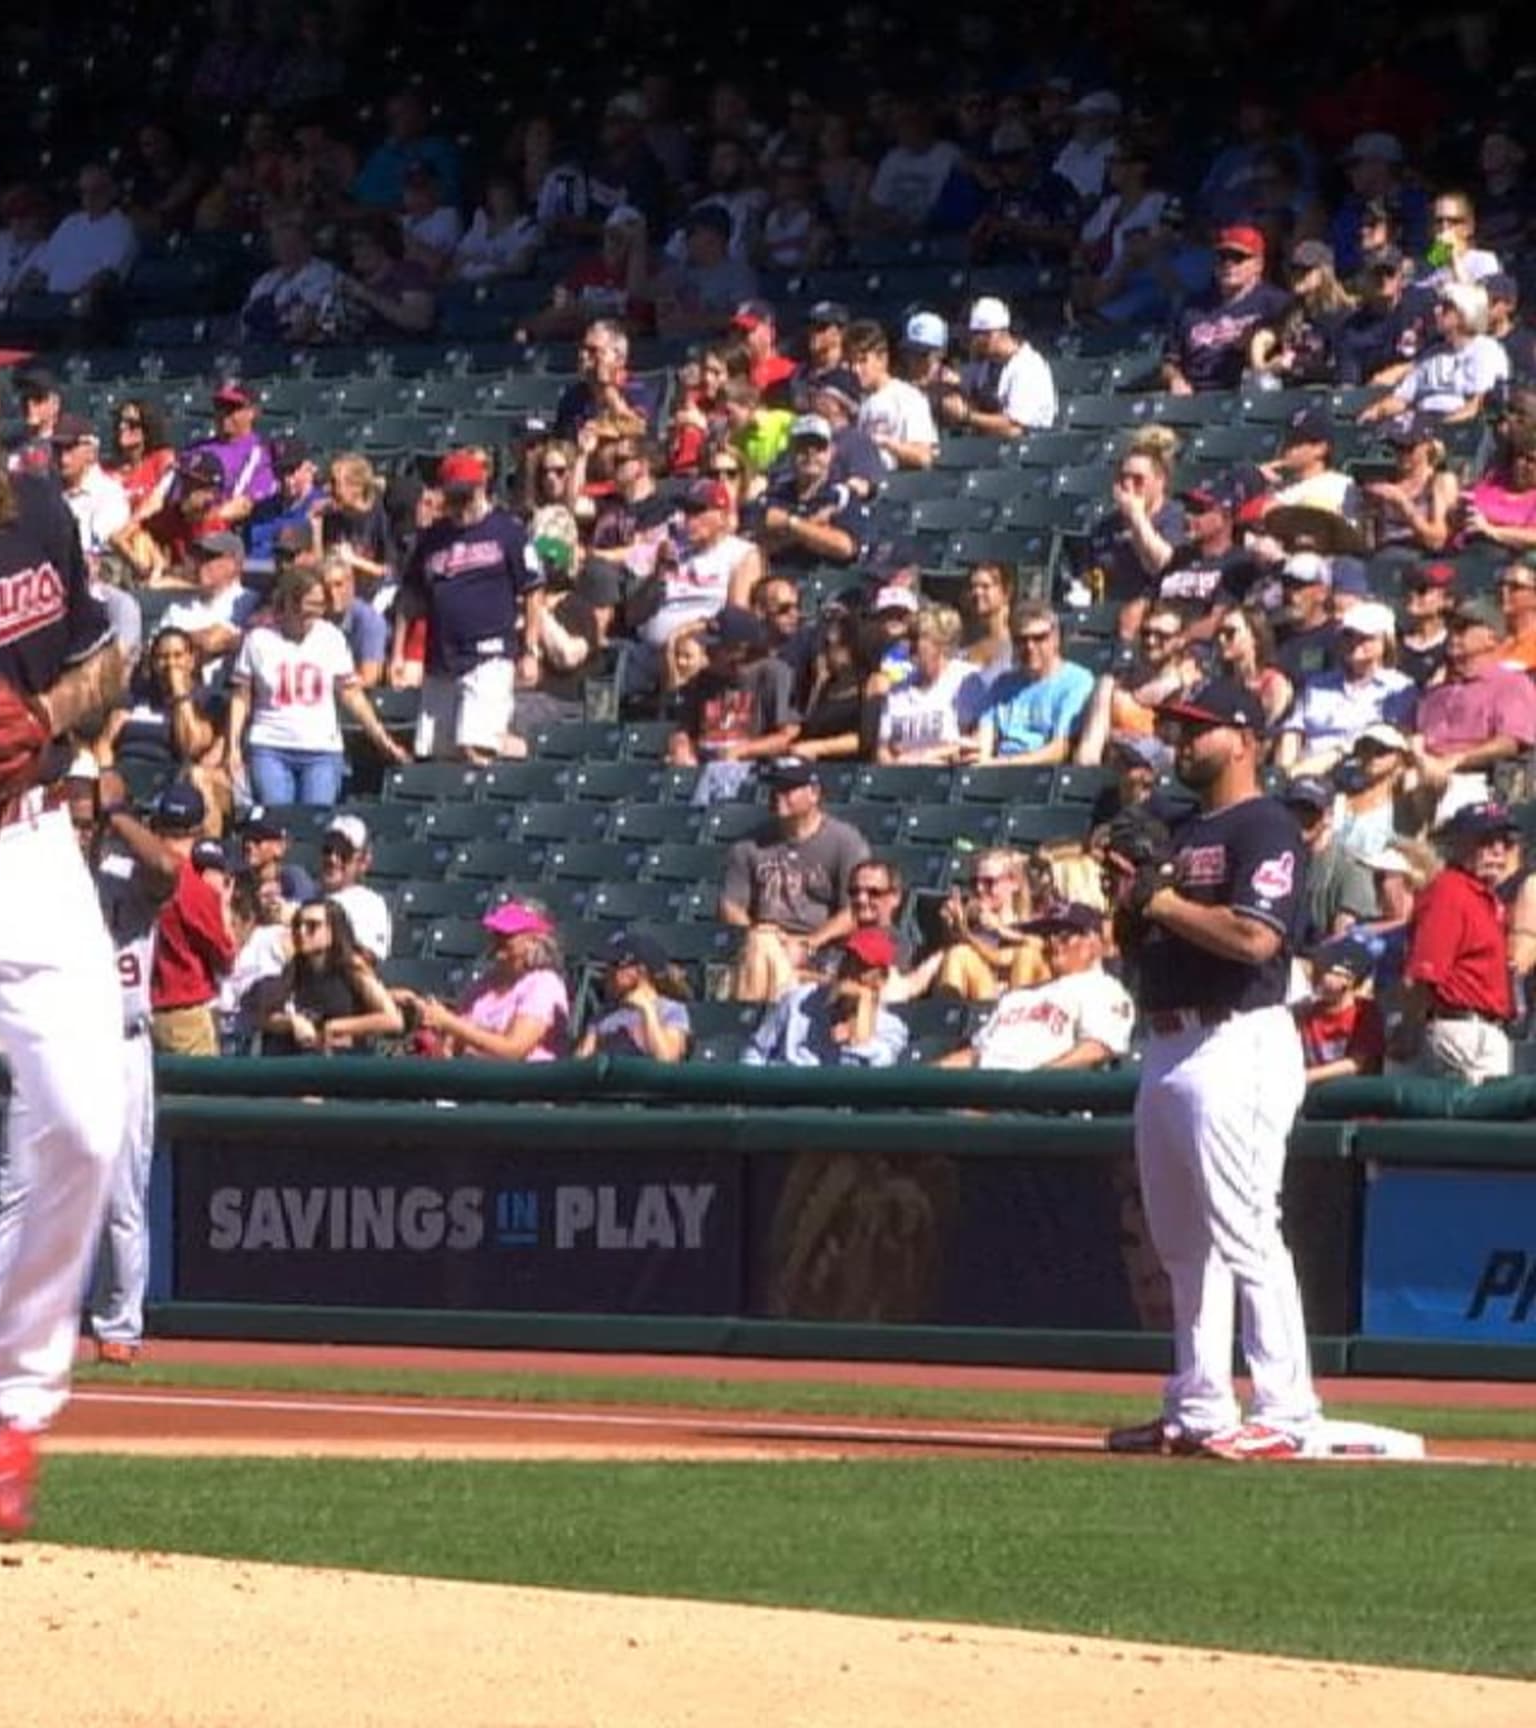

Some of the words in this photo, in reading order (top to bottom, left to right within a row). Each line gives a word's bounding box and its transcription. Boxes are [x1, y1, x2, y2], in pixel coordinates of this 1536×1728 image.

[273, 659, 324, 706] 10
[117, 952, 142, 988] 9
[208, 1184, 484, 1249] SAVINGS
[495, 1189, 539, 1232] IN
[555, 1183, 717, 1249] PLAY
